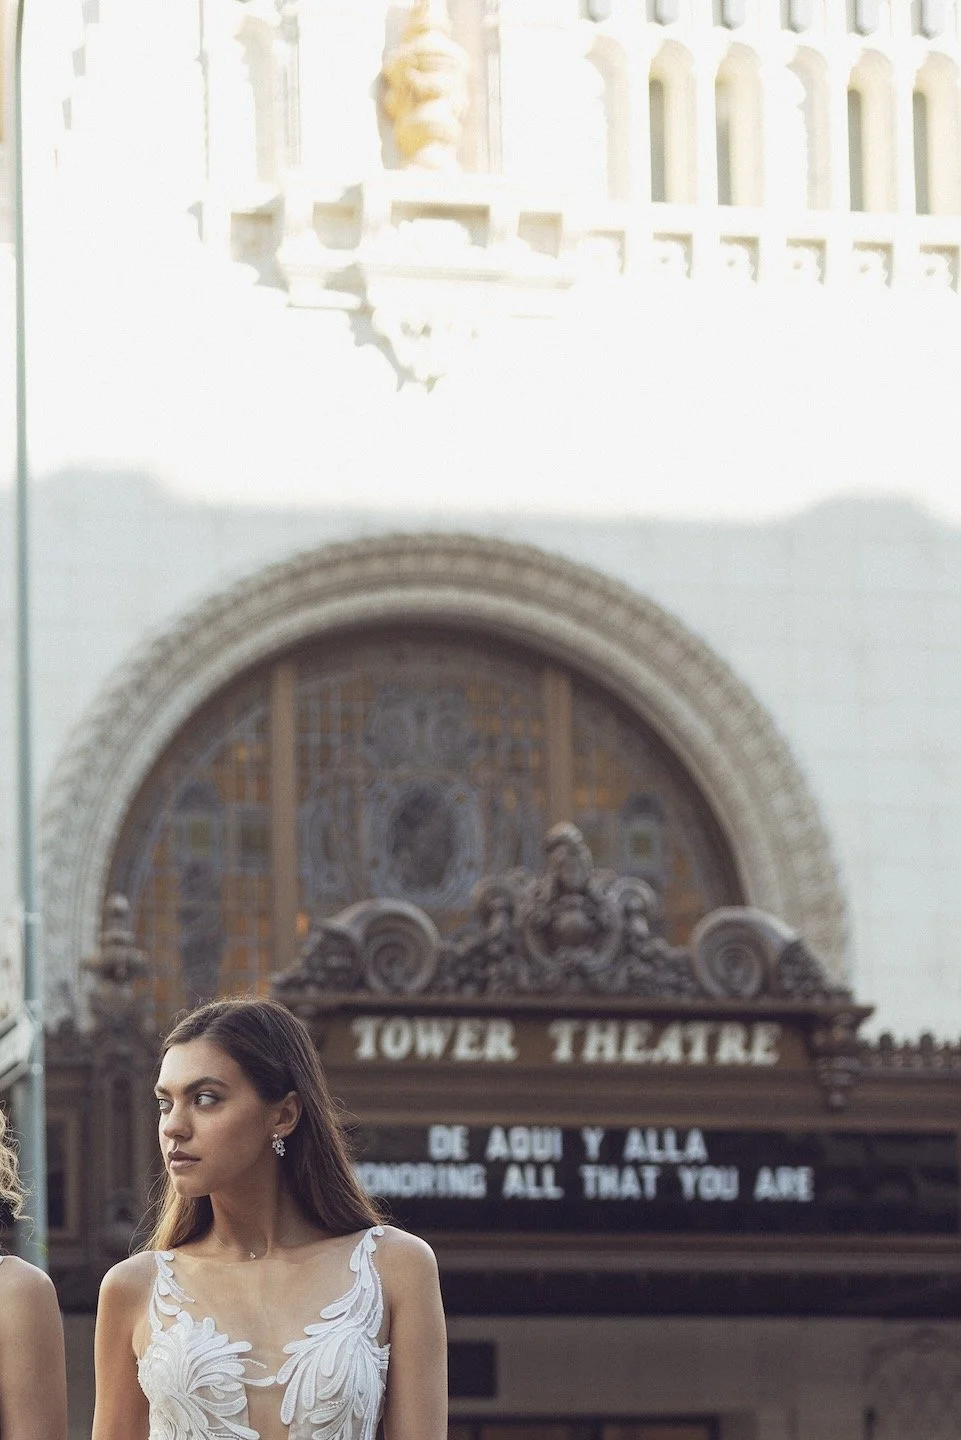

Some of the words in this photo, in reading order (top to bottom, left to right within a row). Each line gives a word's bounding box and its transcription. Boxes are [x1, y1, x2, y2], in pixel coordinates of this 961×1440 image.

[352, 1015, 519, 1062] TOWER
[548, 1017, 782, 1066] THEATRE
[428, 1124, 469, 1161] DE
[485, 1125, 563, 1162] AQUI
[581, 1126, 605, 1161] Y
[622, 1127, 709, 1163] ALLA
[502, 1163, 565, 1199] ALL
[579, 1164, 661, 1200] THAT
[677, 1165, 739, 1201] YOU
[753, 1165, 815, 1202] ARE
